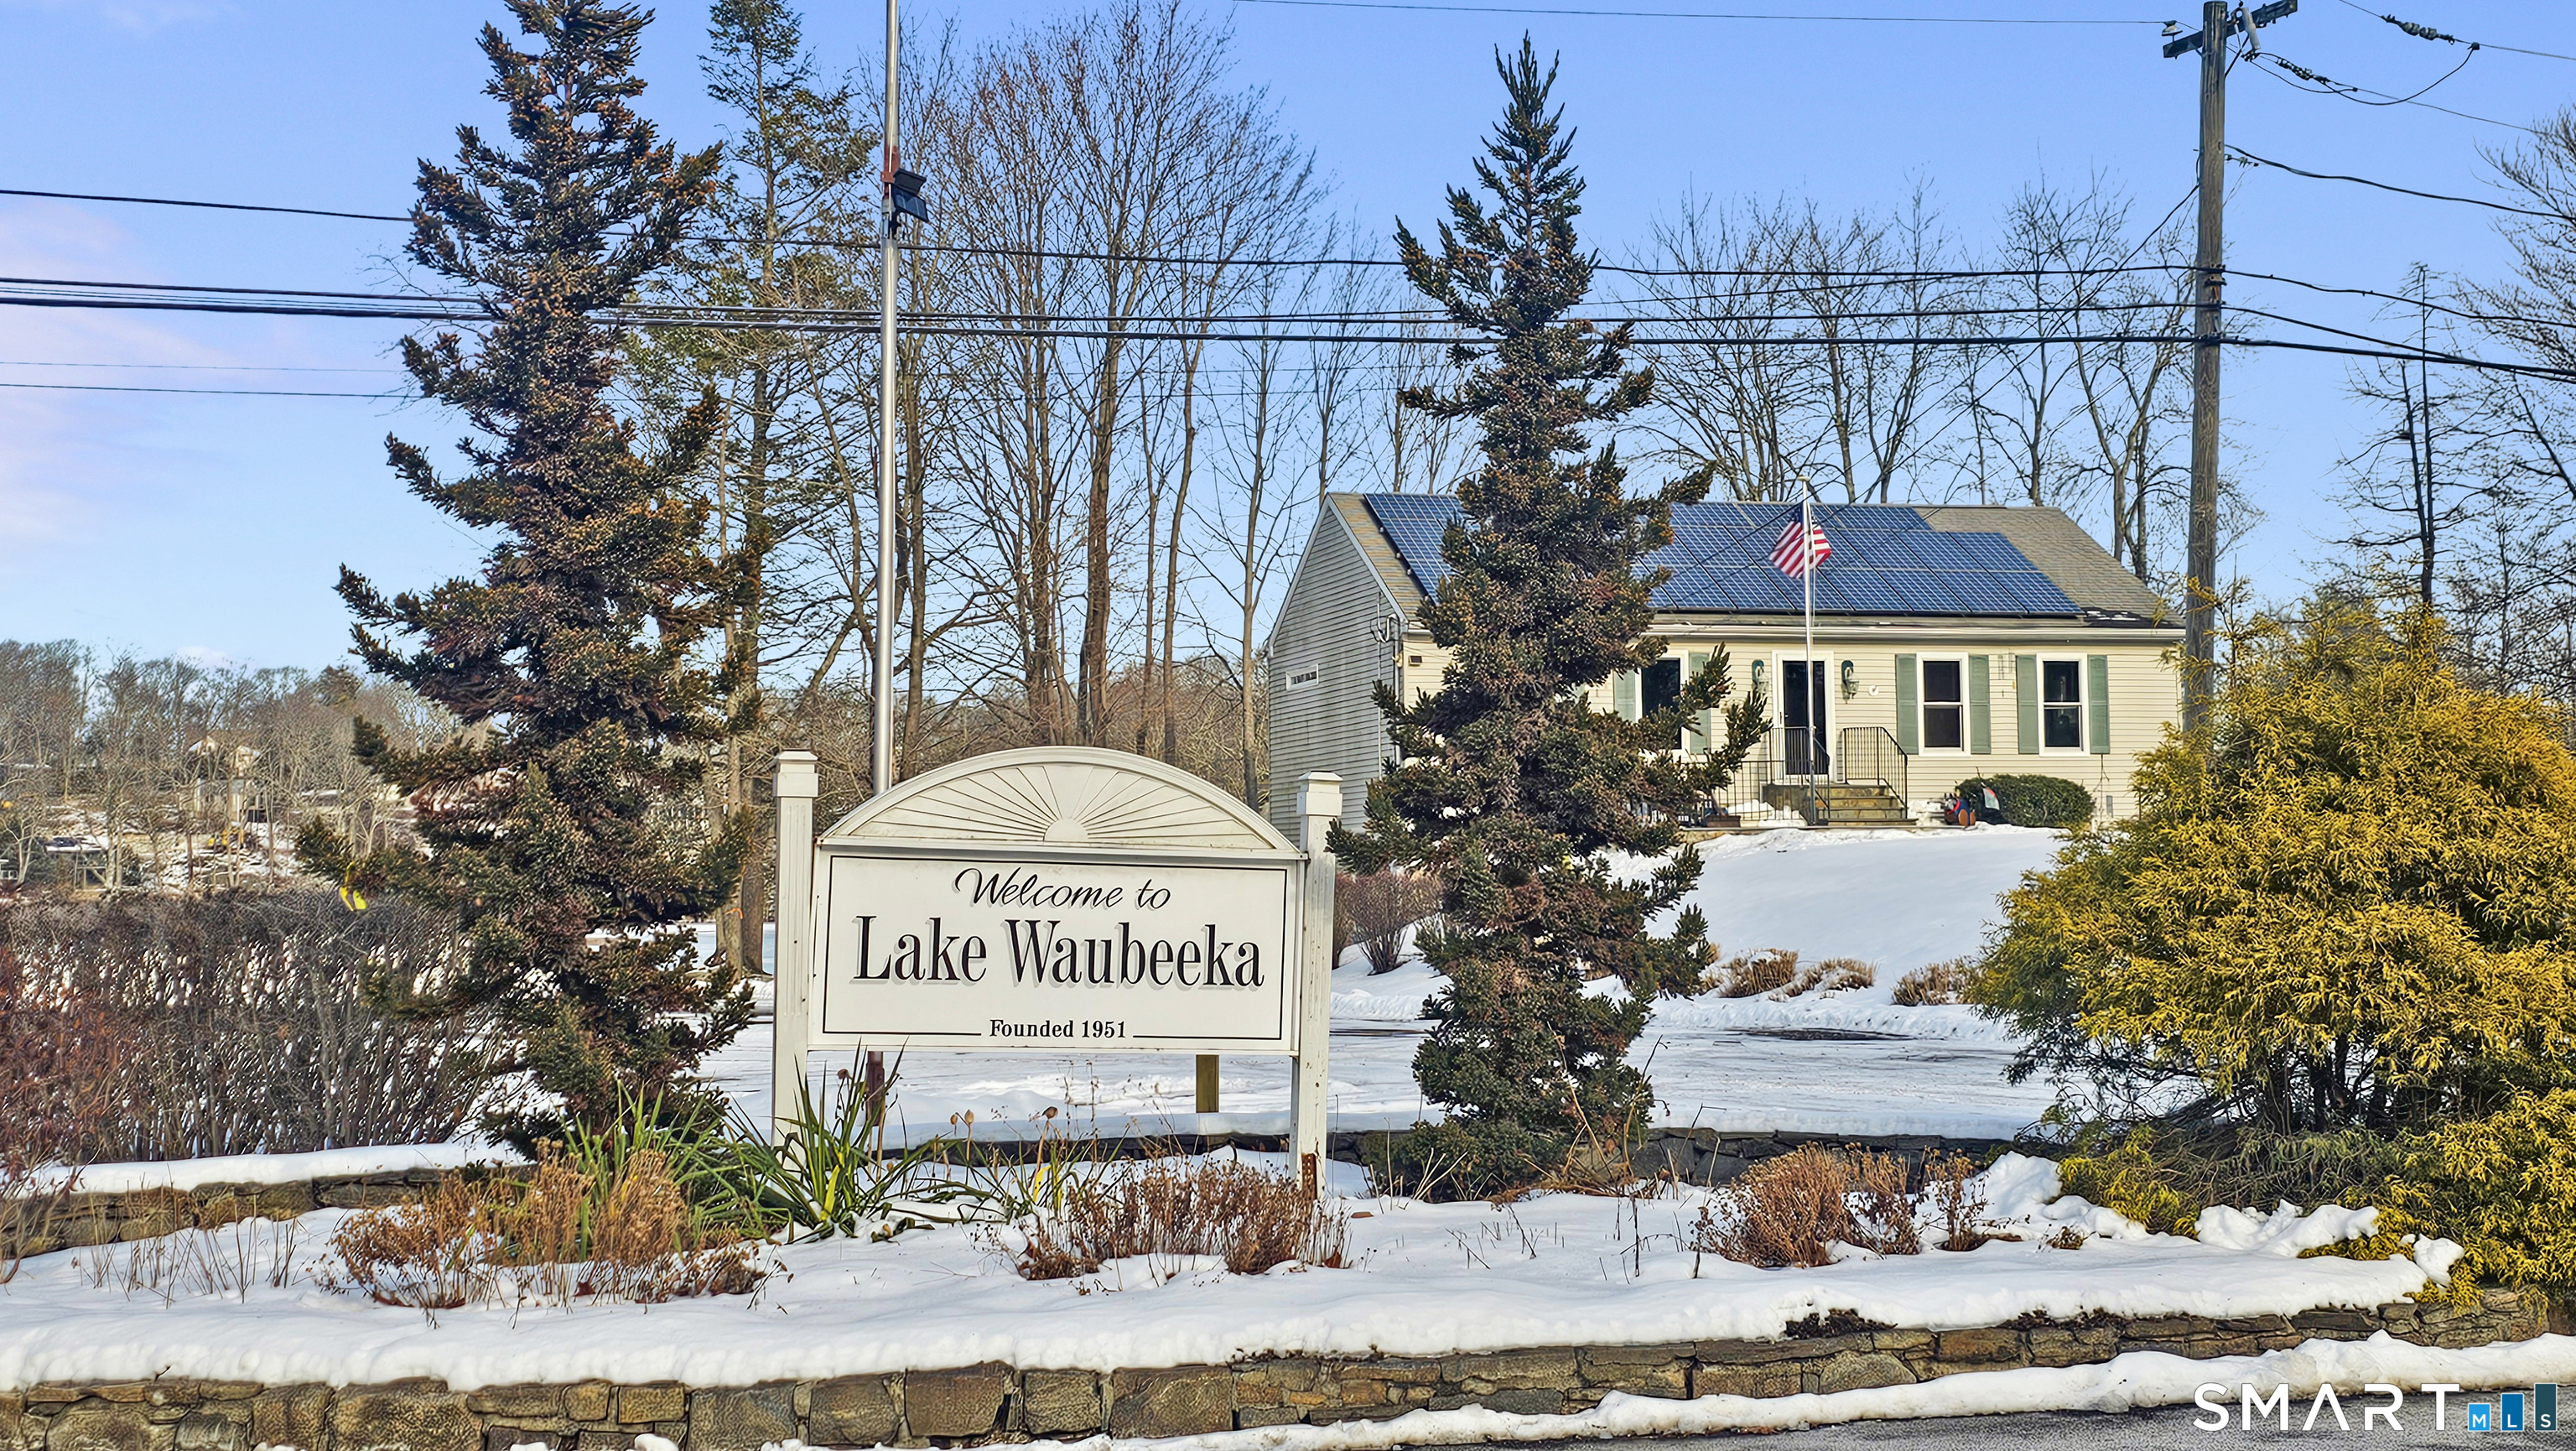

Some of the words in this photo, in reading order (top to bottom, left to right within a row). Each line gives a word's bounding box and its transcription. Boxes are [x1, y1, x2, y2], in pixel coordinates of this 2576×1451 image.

[954, 866, 1124, 909] Welcome
[1136, 878, 1171, 910] to
[852, 914, 988, 983] Lake
[1004, 918, 1265, 988] Waubeeka
[989, 1019, 1074, 1038] Founded
[1081, 1020, 1126, 1038] 1951
